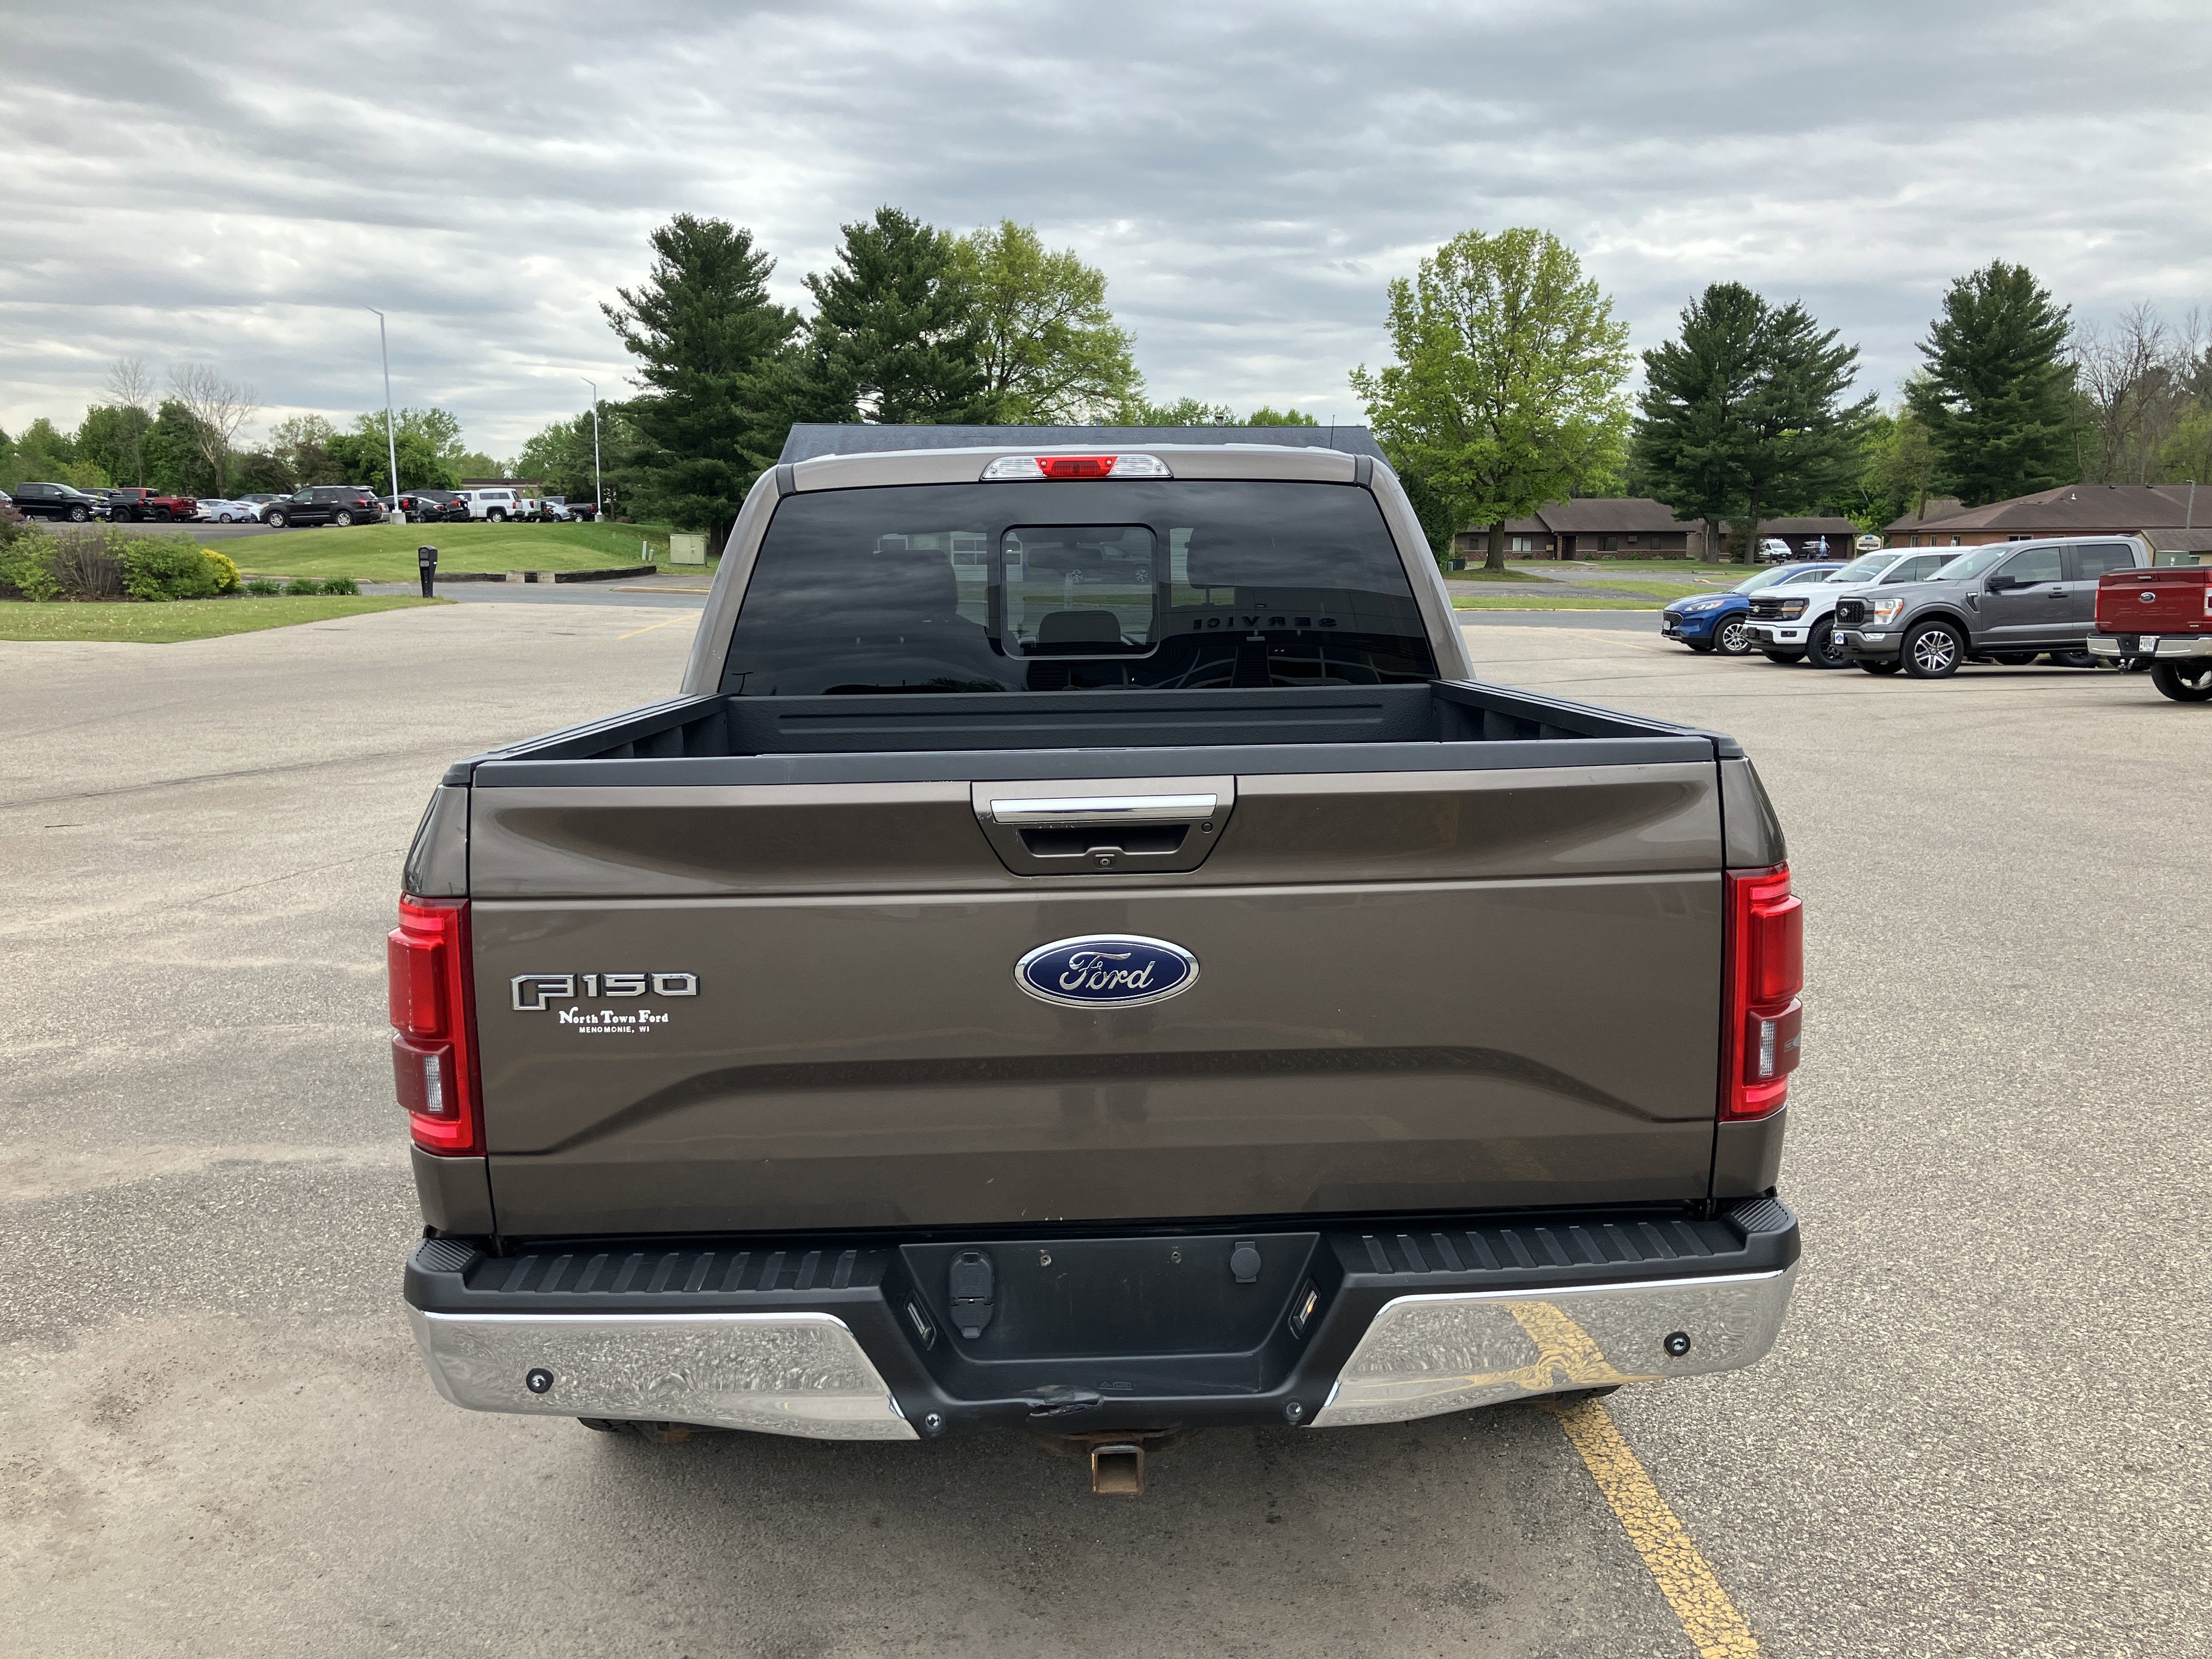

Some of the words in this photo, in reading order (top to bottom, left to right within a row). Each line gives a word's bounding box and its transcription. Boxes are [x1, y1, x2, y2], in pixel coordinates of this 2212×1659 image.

[1059, 951, 1156, 990] Ford
[558, 1006, 599, 1024] North
[600, 1010, 636, 1024] Town
[638, 1009, 669, 1023] Ford
